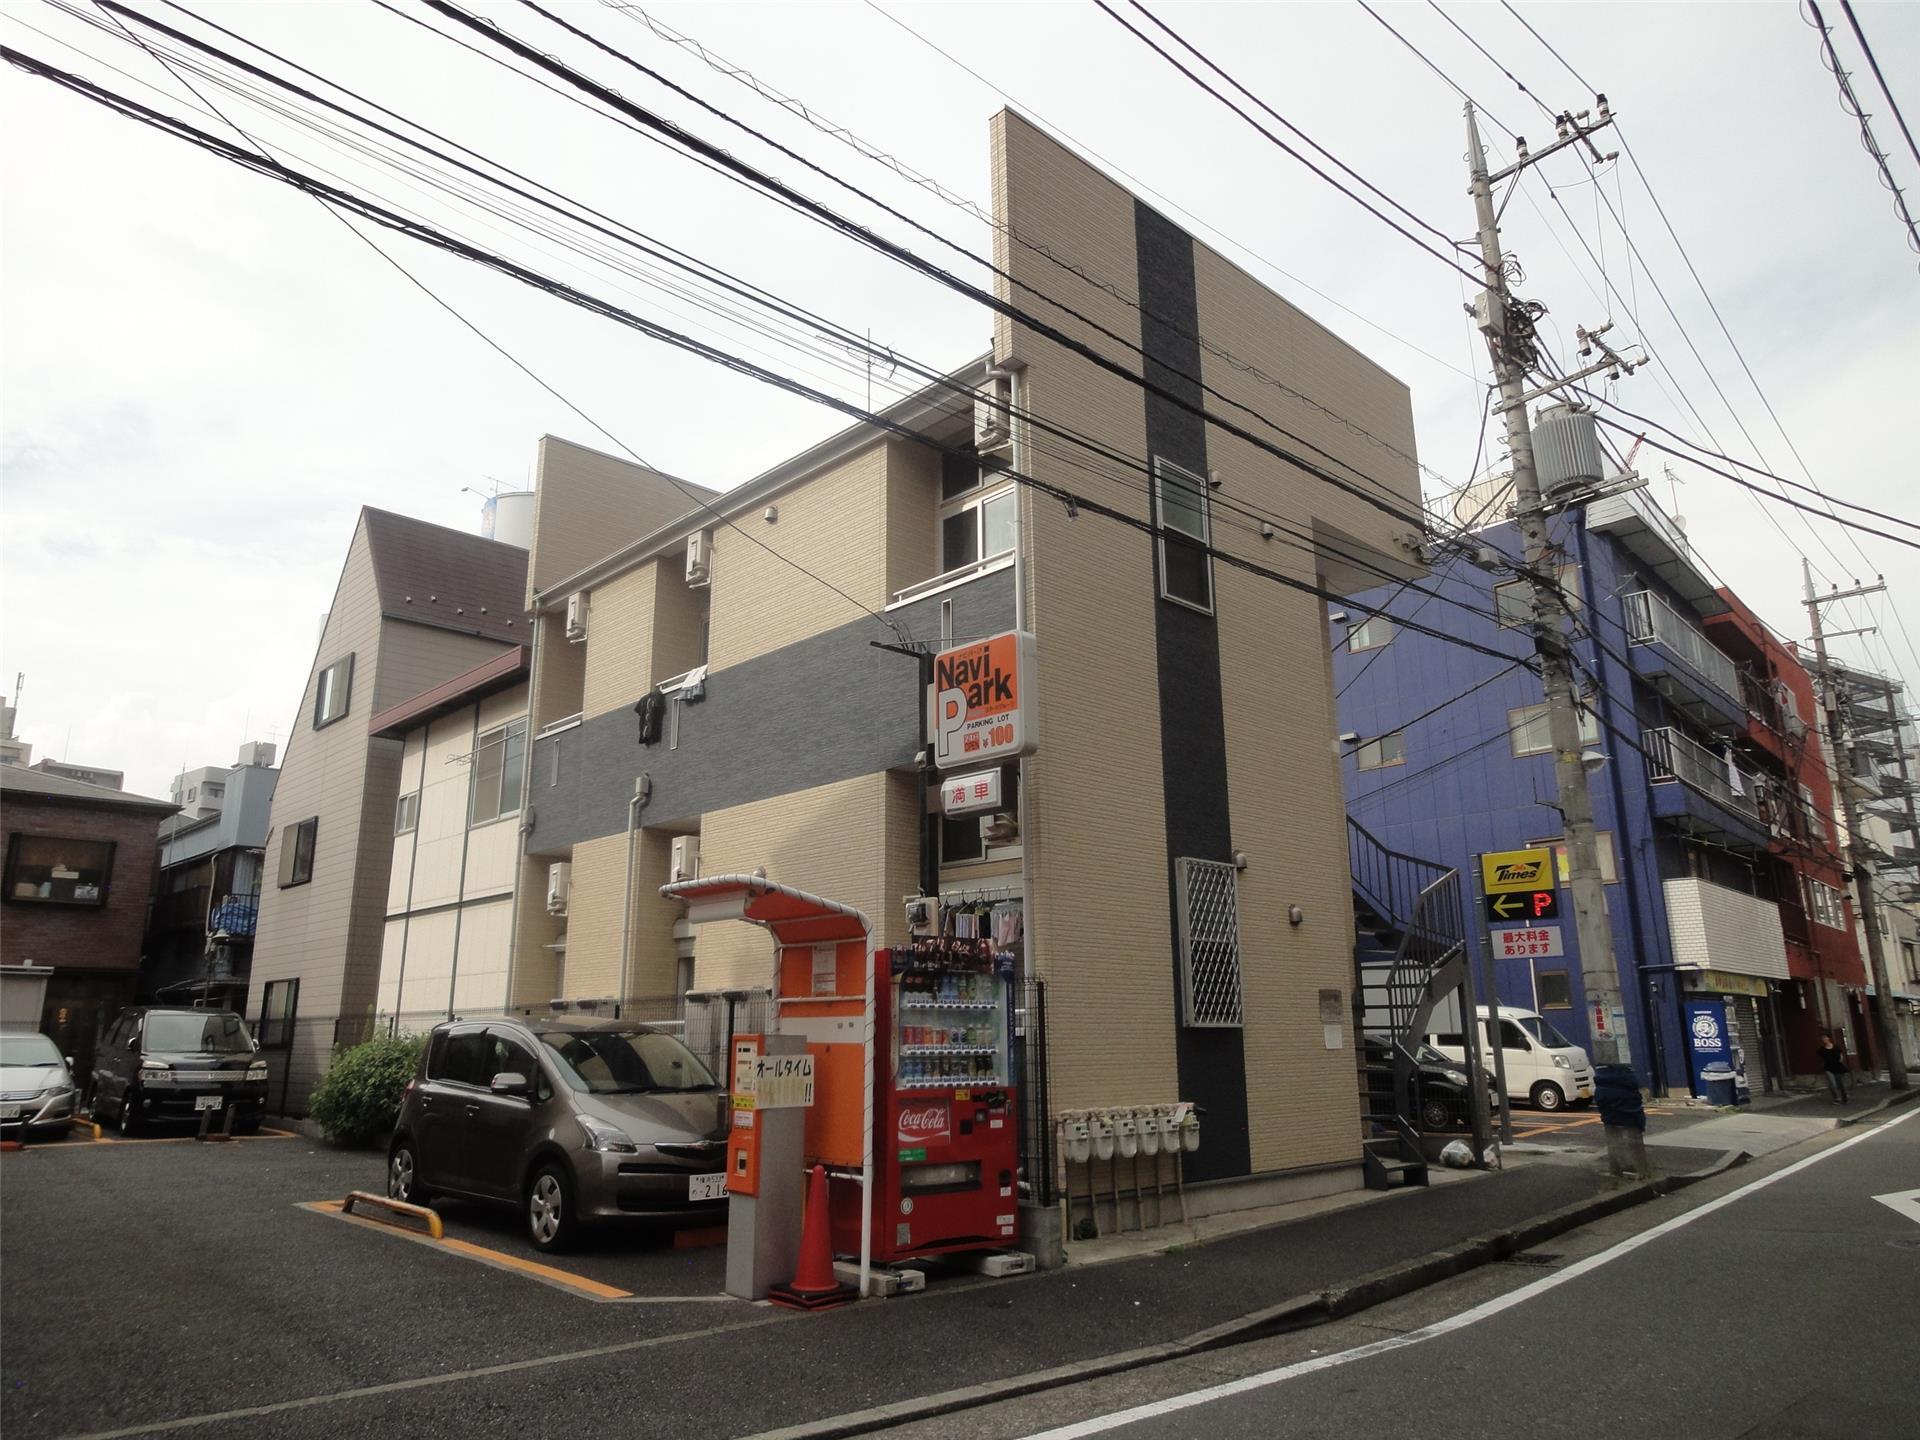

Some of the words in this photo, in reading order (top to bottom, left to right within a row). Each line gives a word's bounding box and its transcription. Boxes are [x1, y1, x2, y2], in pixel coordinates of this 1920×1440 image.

[937, 645, 990, 692] Navi
[938, 667, 1013, 758] Park
[966, 717, 994, 730] PARKING
[997, 713, 1010, 723] LOT
[951, 779, 990, 805] 満車
[1496, 867, 1538, 882] Times
[1533, 893, 1552, 917] P
[1503, 929, 1550, 943] 最大料金
[1504, 942, 1550, 955] あります
[1693, 1038, 1722, 1048] BOSS
[757, 1058, 812, 1078] オールタイム
